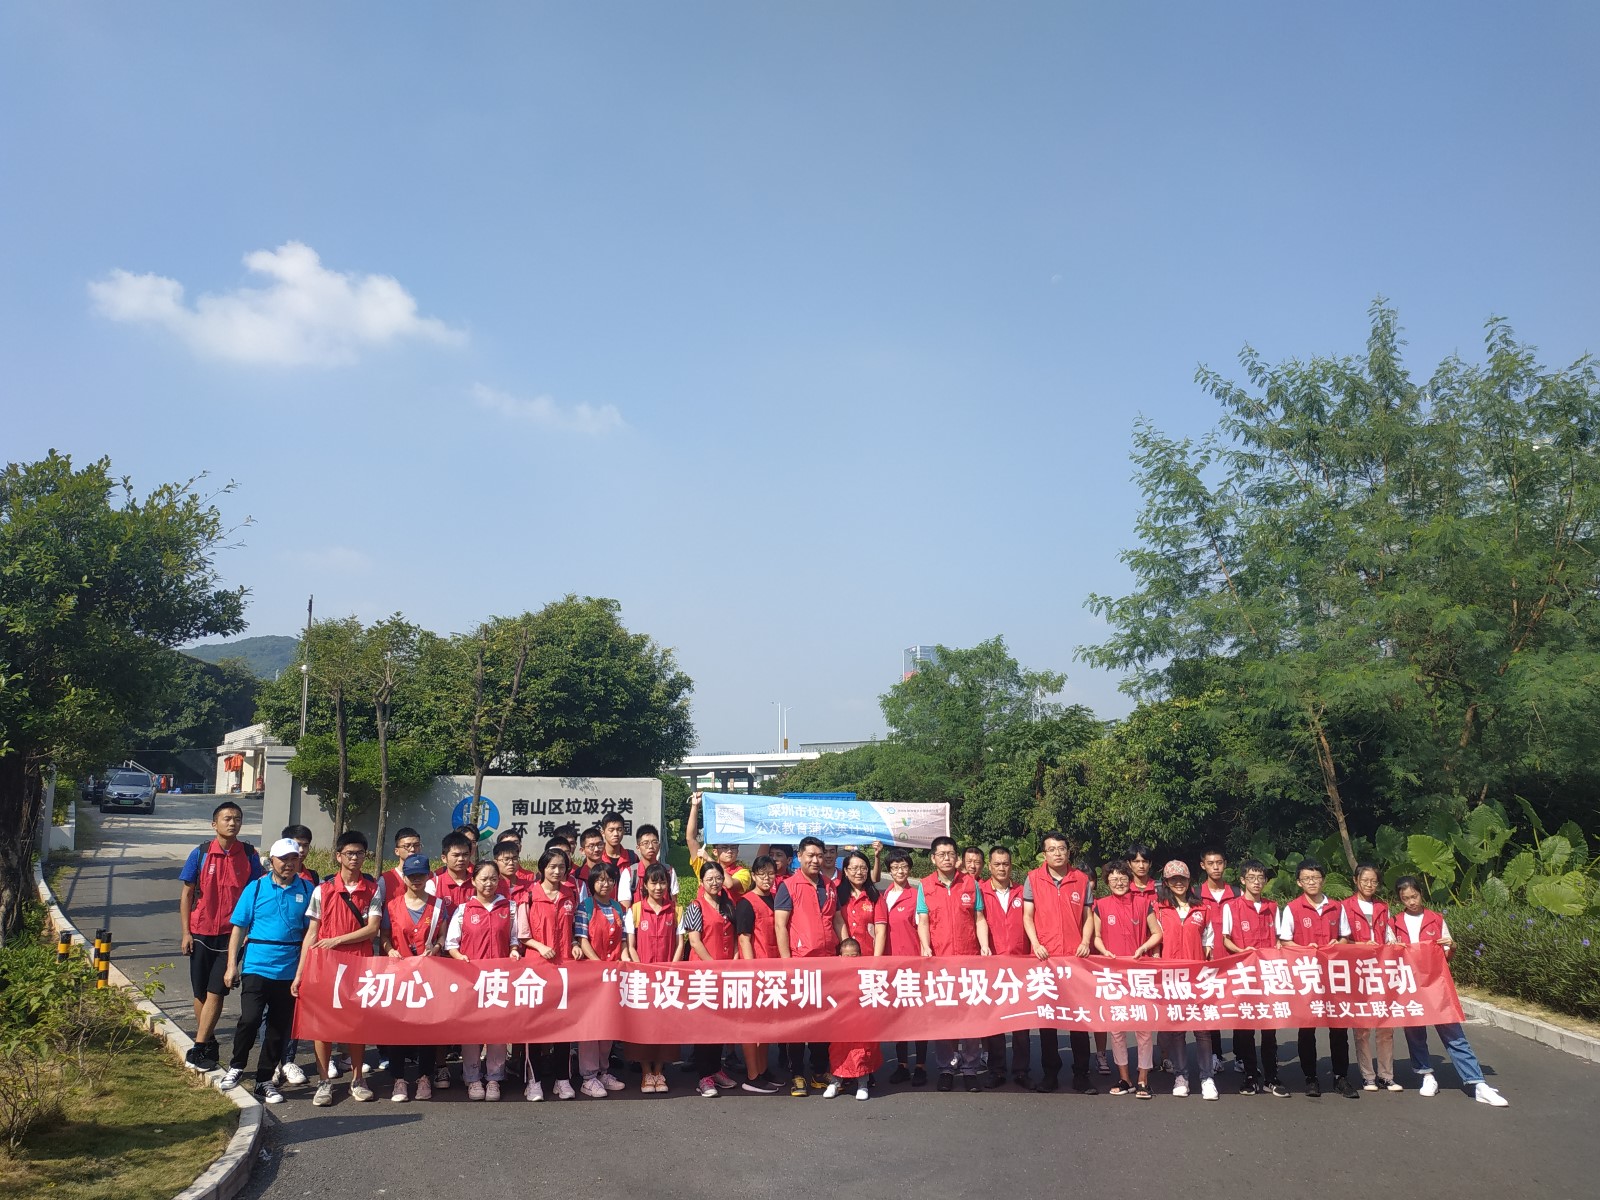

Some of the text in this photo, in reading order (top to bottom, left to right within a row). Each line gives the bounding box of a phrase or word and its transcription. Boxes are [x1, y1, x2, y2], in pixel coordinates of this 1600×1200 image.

[512, 798, 634, 816] 南山区垃圾分类
[767, 804, 861, 820] 深圳市垃圾分类
[1092, 956, 1418, 1001] 志愿服务主题党日活动
[1310, 999, 1425, 1019] 学生义工联合会
